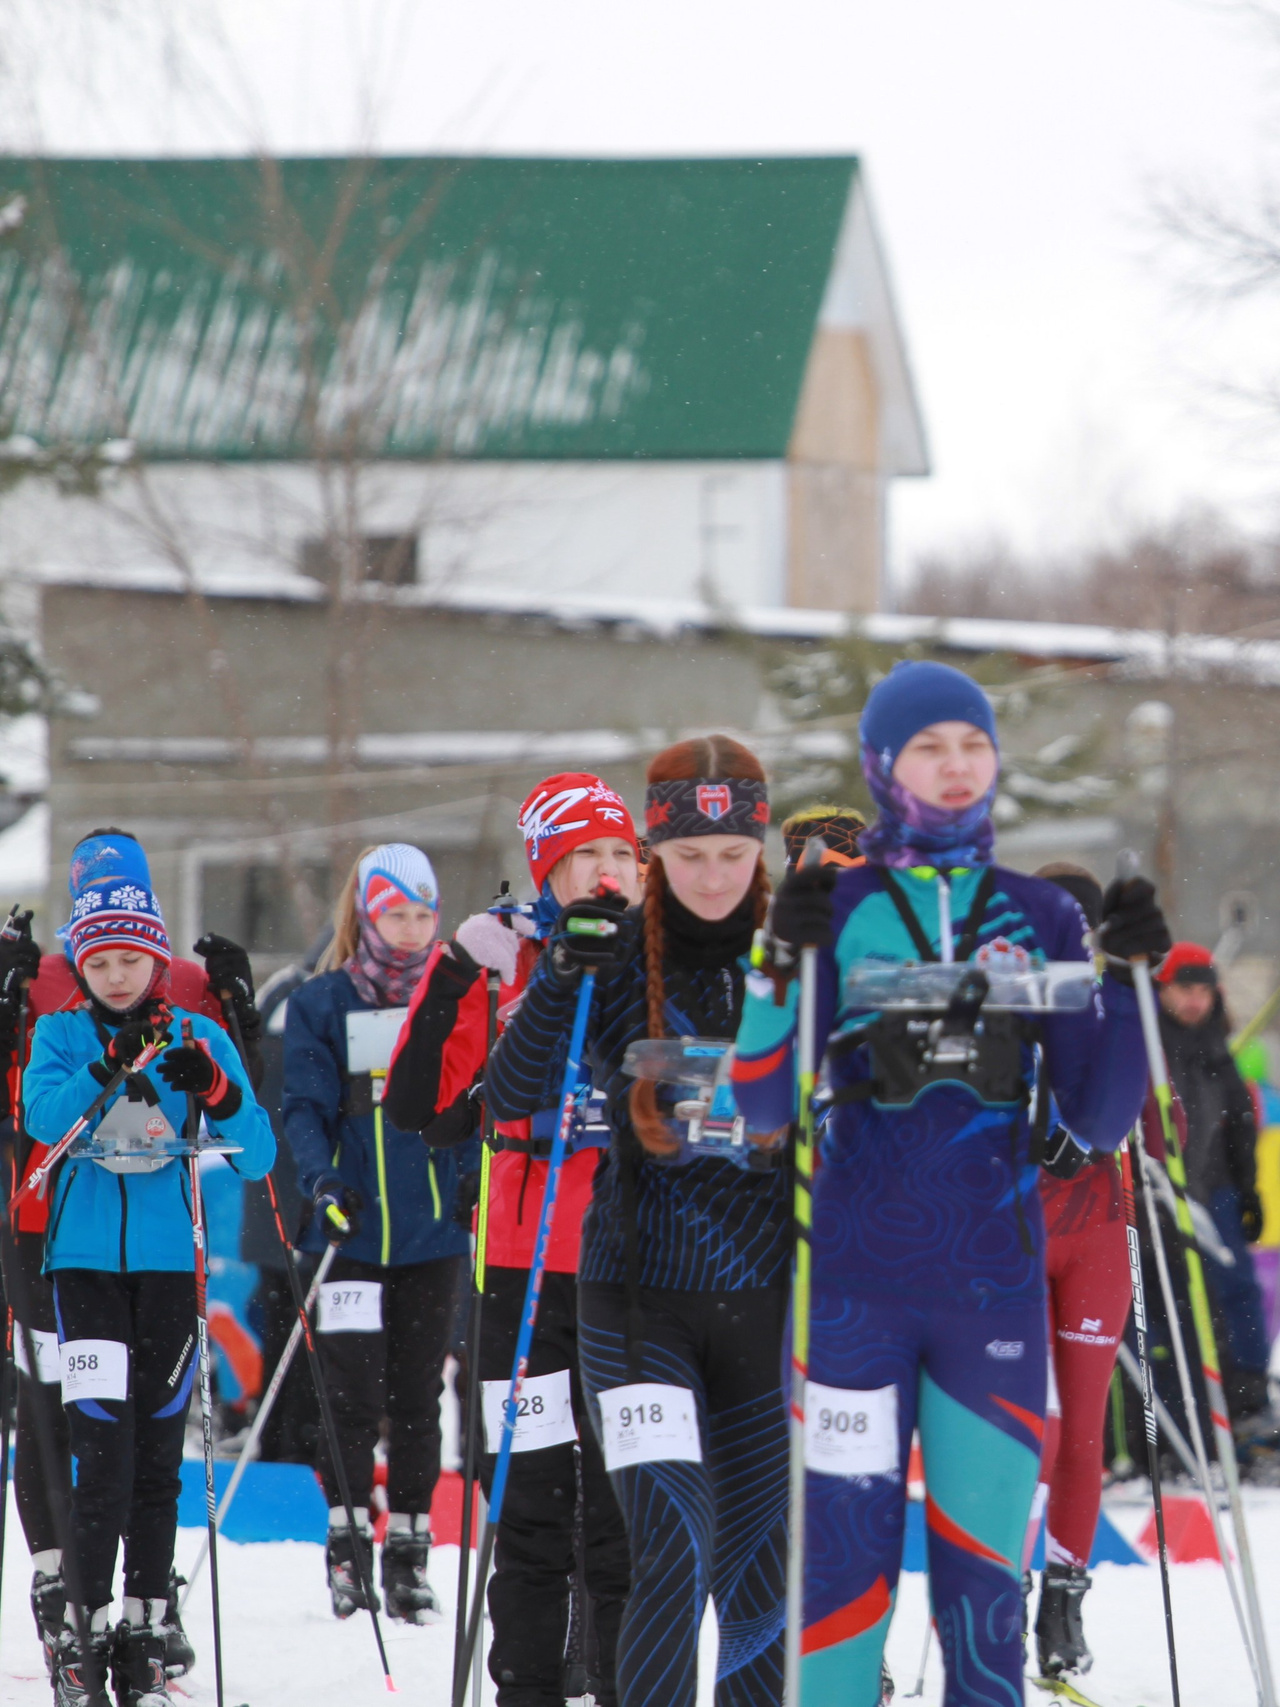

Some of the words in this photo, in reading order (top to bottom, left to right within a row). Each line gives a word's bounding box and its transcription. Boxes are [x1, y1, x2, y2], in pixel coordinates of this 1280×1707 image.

[332, 1291, 362, 1306] 977
[1057, 1329, 1117, 1345] NORDSKI
[67, 1353, 99, 1373] 958
[619, 1402, 664, 1428] 918
[819, 1407, 868, 1434] 908
